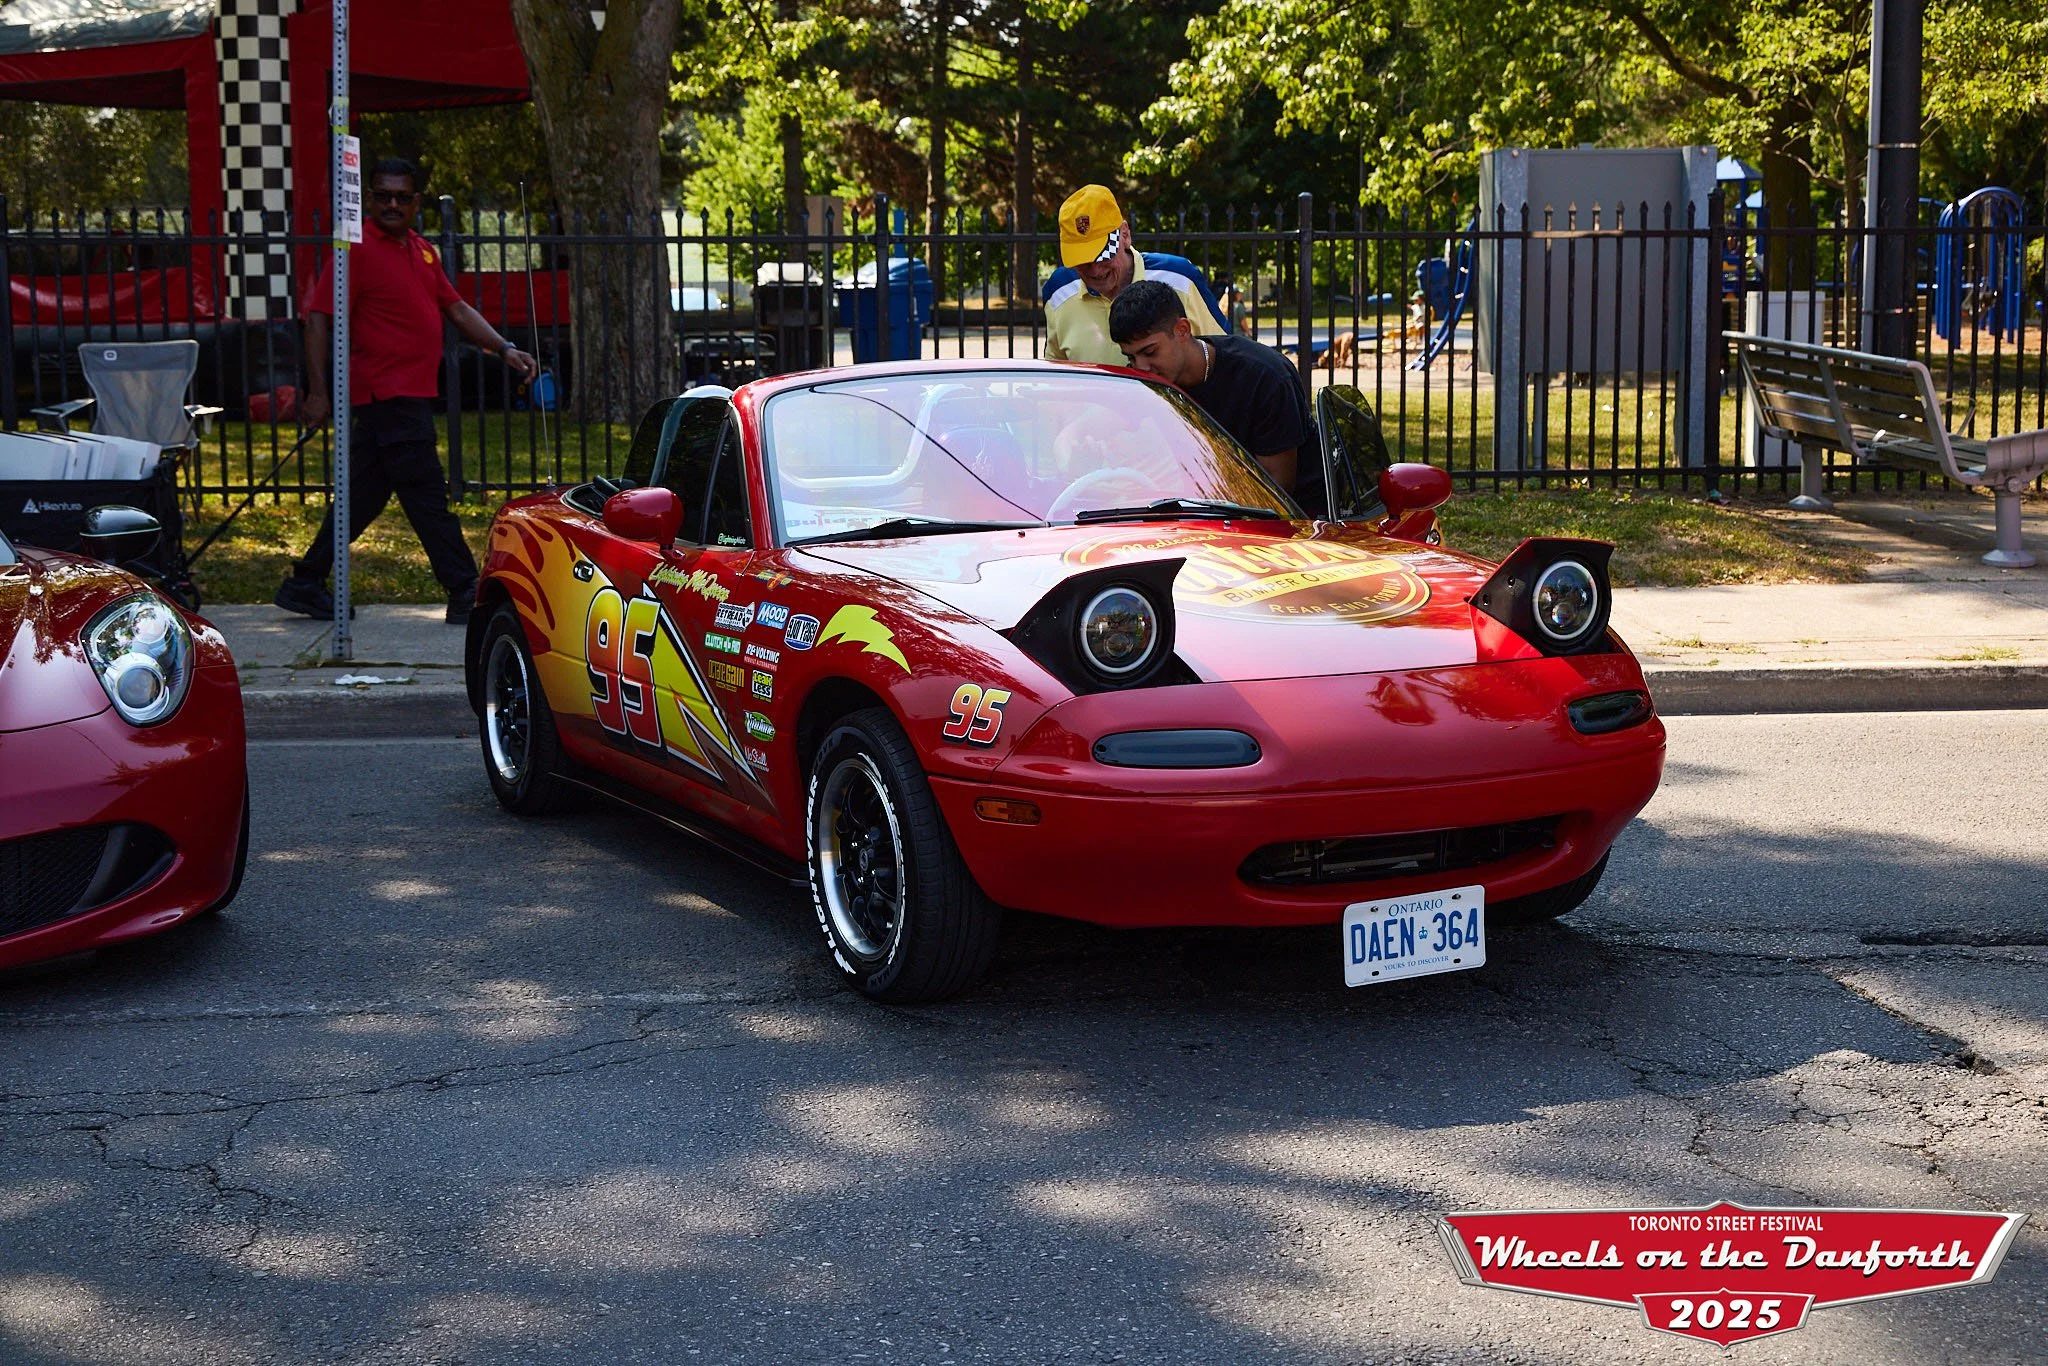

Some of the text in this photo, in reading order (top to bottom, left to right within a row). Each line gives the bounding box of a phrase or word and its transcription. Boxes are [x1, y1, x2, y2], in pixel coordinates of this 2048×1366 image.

[1223, 577, 1298, 602] BUMPER
[757, 604, 788, 622] MOOD
[1269, 604, 1325, 614] REAR
[1329, 599, 1370, 612] END
[586, 587, 661, 747] 95
[943, 683, 1011, 746] 95
[1388, 899, 1443, 917] ONTARIO
[1351, 908, 1479, 965] DAEN 364
[1384, 962, 1405, 971] YOURS
[1418, 955, 1449, 966] DISCOVER
